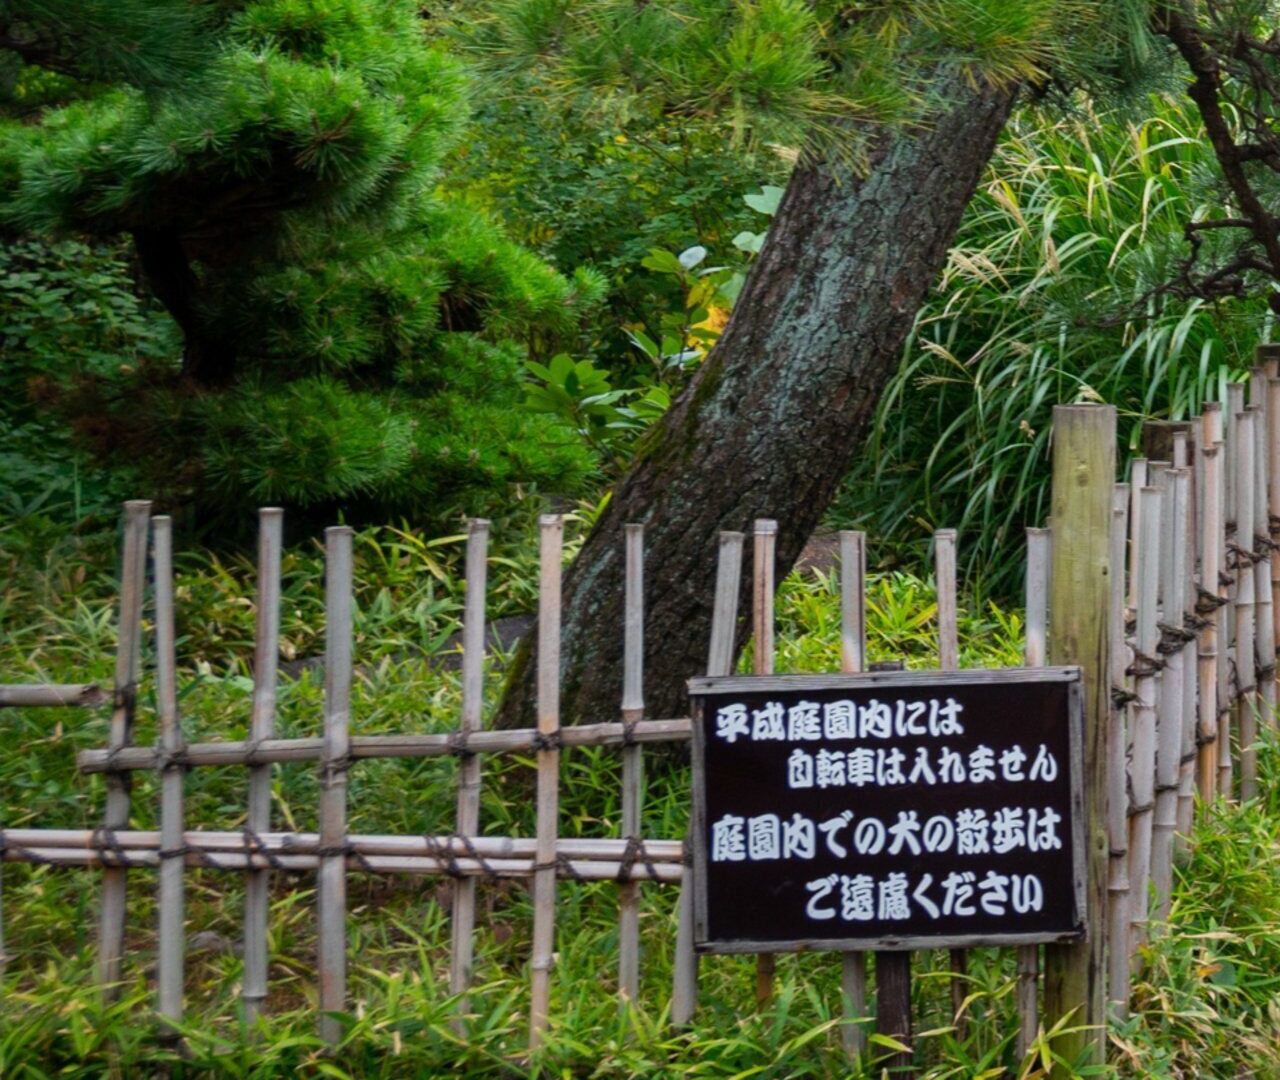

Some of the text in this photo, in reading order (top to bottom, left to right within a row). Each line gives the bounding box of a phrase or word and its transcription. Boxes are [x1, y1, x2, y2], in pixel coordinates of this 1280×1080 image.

[714, 697, 965, 743] 平成庭園内には
[787, 744, 1058, 789] 自転車は入れません
[711, 807, 1062, 862] 庭園内での犬の散歩は
[805, 870, 1044, 921] ご遠慮ください
